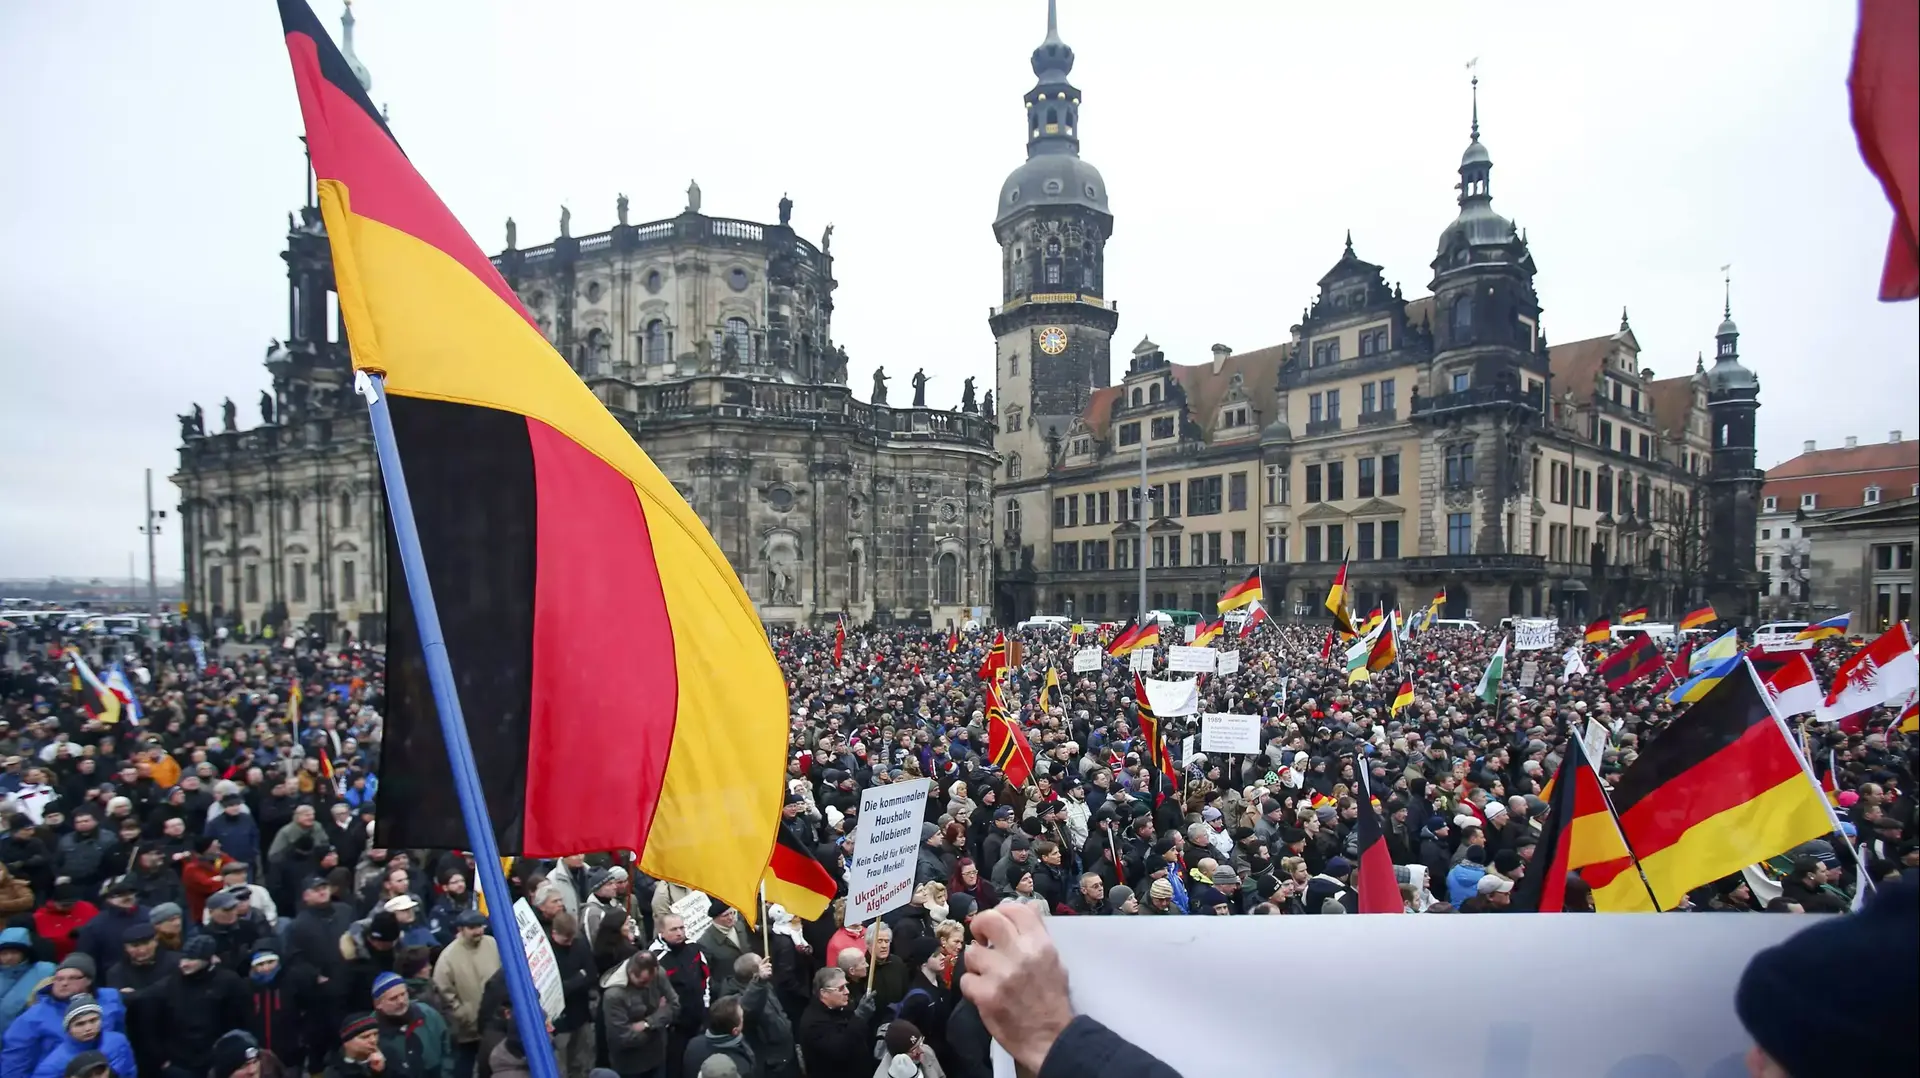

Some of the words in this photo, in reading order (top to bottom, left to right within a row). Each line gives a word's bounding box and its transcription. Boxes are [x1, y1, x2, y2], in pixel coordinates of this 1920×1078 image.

[1516, 620, 1557, 635] EUROPE
[1516, 633, 1555, 646] AWAKE
[864, 800, 878, 812] Die
[879, 789, 926, 809] kommunalen
[875, 810, 912, 826] Haushalte
[870, 826, 912, 844] kollabieren
[856, 855, 871, 867] Kein
[873, 850, 889, 863] Geld
[889, 847, 899, 859] für
[899, 843, 918, 855] Kriege
[866, 867, 882, 878] Frau
[882, 860, 905, 874] Merkel!
[855, 880, 889, 906] Ukraine
[866, 877, 912, 913] Afghanistan
